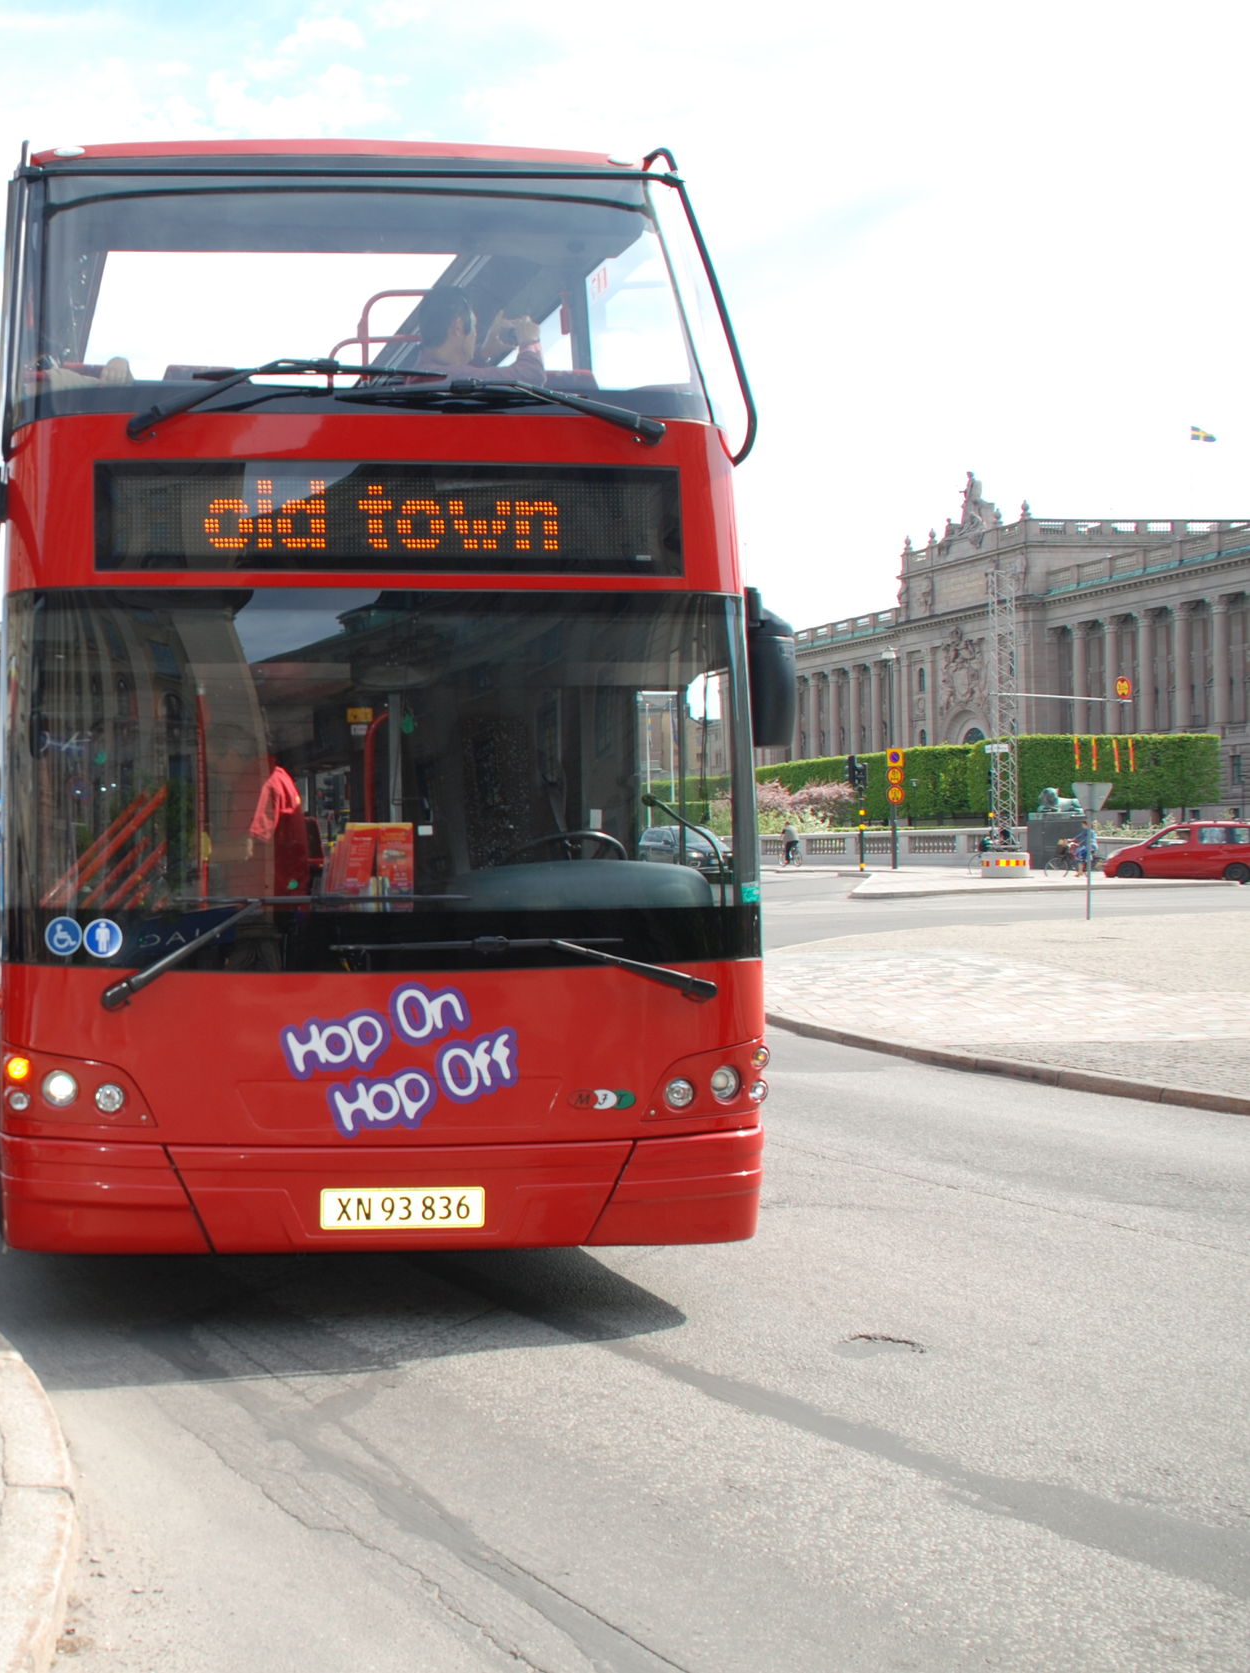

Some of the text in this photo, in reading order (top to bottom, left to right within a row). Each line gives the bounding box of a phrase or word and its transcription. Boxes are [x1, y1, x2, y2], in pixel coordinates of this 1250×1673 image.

[204, 479, 560, 551] old town
[396, 988, 464, 1039] On
[441, 1033, 511, 1097] Off
[336, 1195, 471, 1222] XN 93 836
